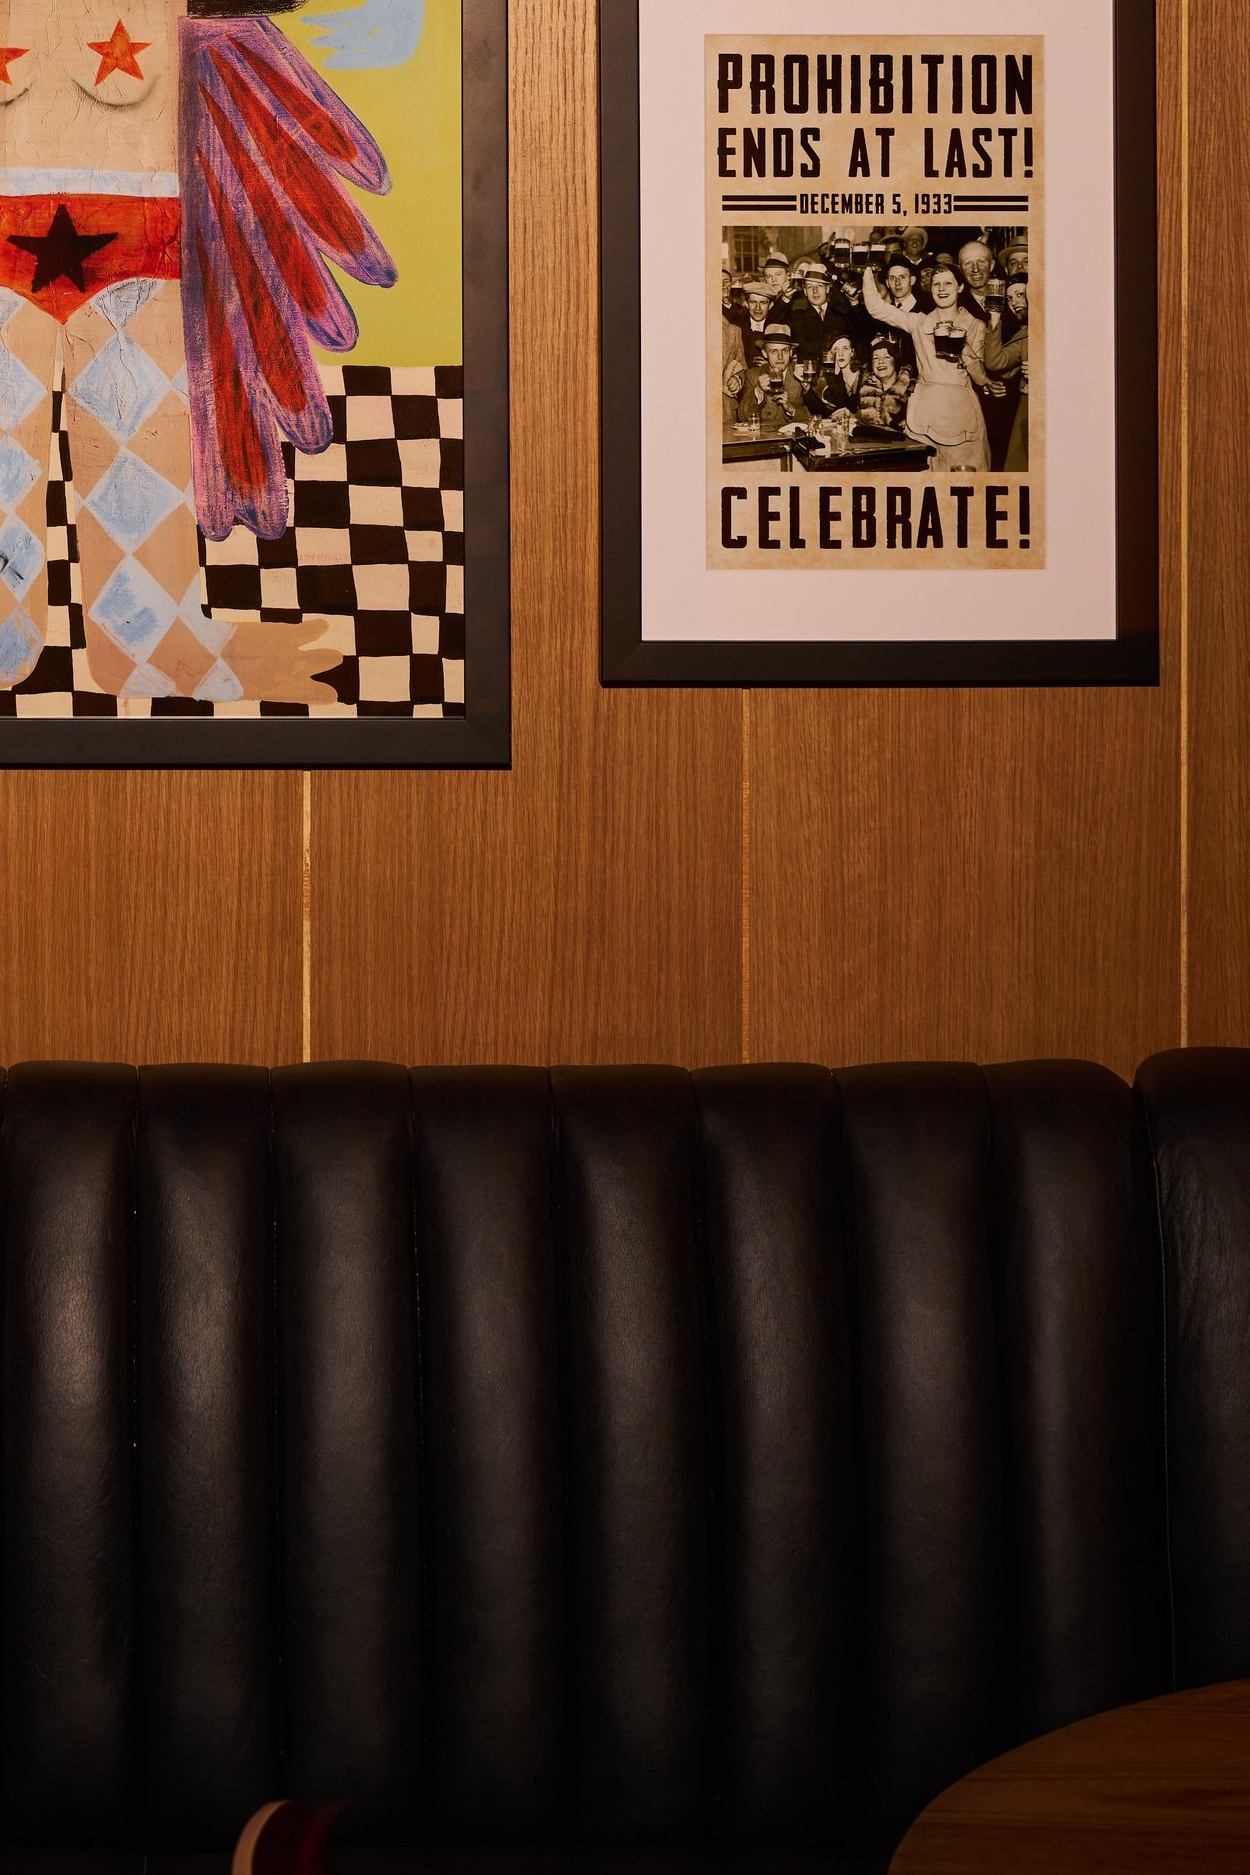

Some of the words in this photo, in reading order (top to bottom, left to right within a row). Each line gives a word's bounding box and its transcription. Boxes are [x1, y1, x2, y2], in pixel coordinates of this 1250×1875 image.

[718, 53, 1033, 115] PROHIBITION
[718, 127, 821, 178] ENDS
[848, 127, 895, 178] AT
[923, 127, 1034, 178] LAST!
[799, 193, 885, 215] DECEMBER
[892, 193, 908, 217] 5,
[914, 193, 954, 215] 1933
[721, 486, 1031, 550] CELEBRATE!
